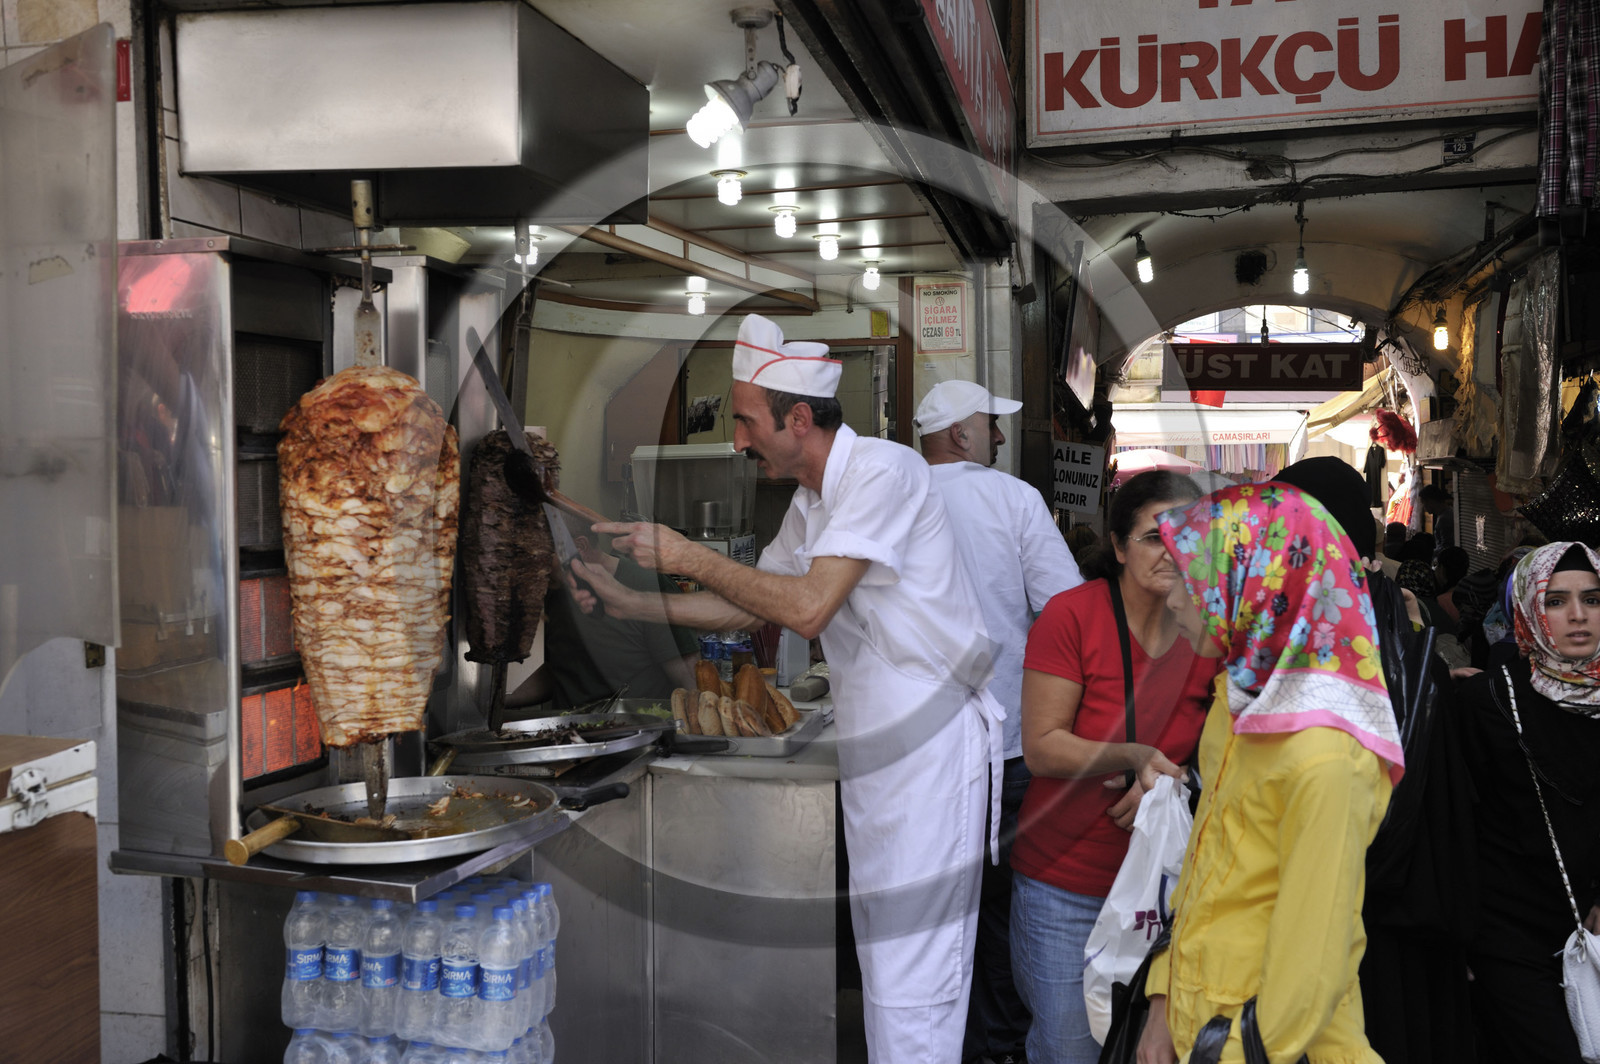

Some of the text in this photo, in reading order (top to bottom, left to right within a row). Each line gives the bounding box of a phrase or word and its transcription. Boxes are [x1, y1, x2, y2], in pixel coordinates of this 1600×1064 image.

[1044, 14, 1399, 111] KÜRKÇÜ
[1453, 143, 1467, 152] 129
[924, 305, 958, 315] SİGARA
[924, 315, 958, 326] İÇİLMEZ
[922, 326, 962, 338] CEZASI 69 TL
[1177, 349, 1350, 379] ÜST KAT
[1212, 432, 1271, 442] ÇAMAŞIRLARI
[1053, 446, 1092, 466] AİLE
[1053, 490, 1087, 507] ARDIR
[443, 968, 472, 981] SIRMA
[482, 971, 513, 984] SIRMA
